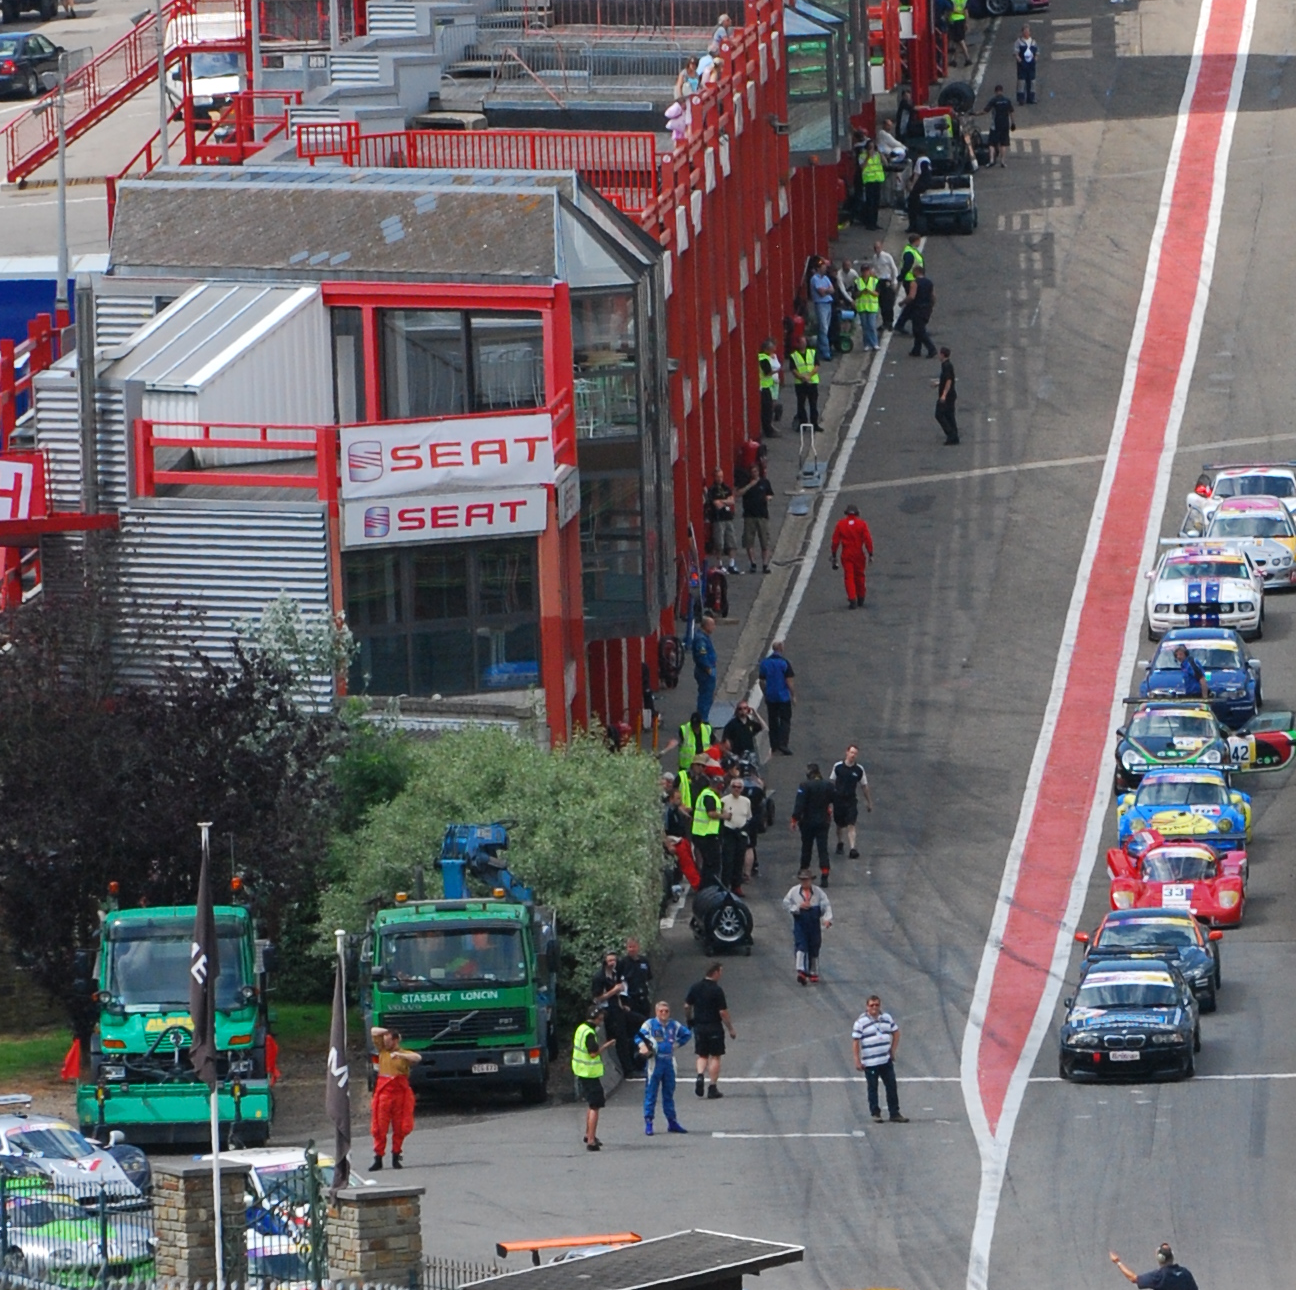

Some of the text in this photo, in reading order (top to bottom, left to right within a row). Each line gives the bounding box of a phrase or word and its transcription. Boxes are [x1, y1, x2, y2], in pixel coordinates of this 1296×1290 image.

[390, 436, 549, 472] SEAT
[397, 500, 528, 531] SEAT
[1231, 745, 1249, 761] 42
[1164, 887, 1185, 897] 33
[402, 993, 452, 1004] STASSART
